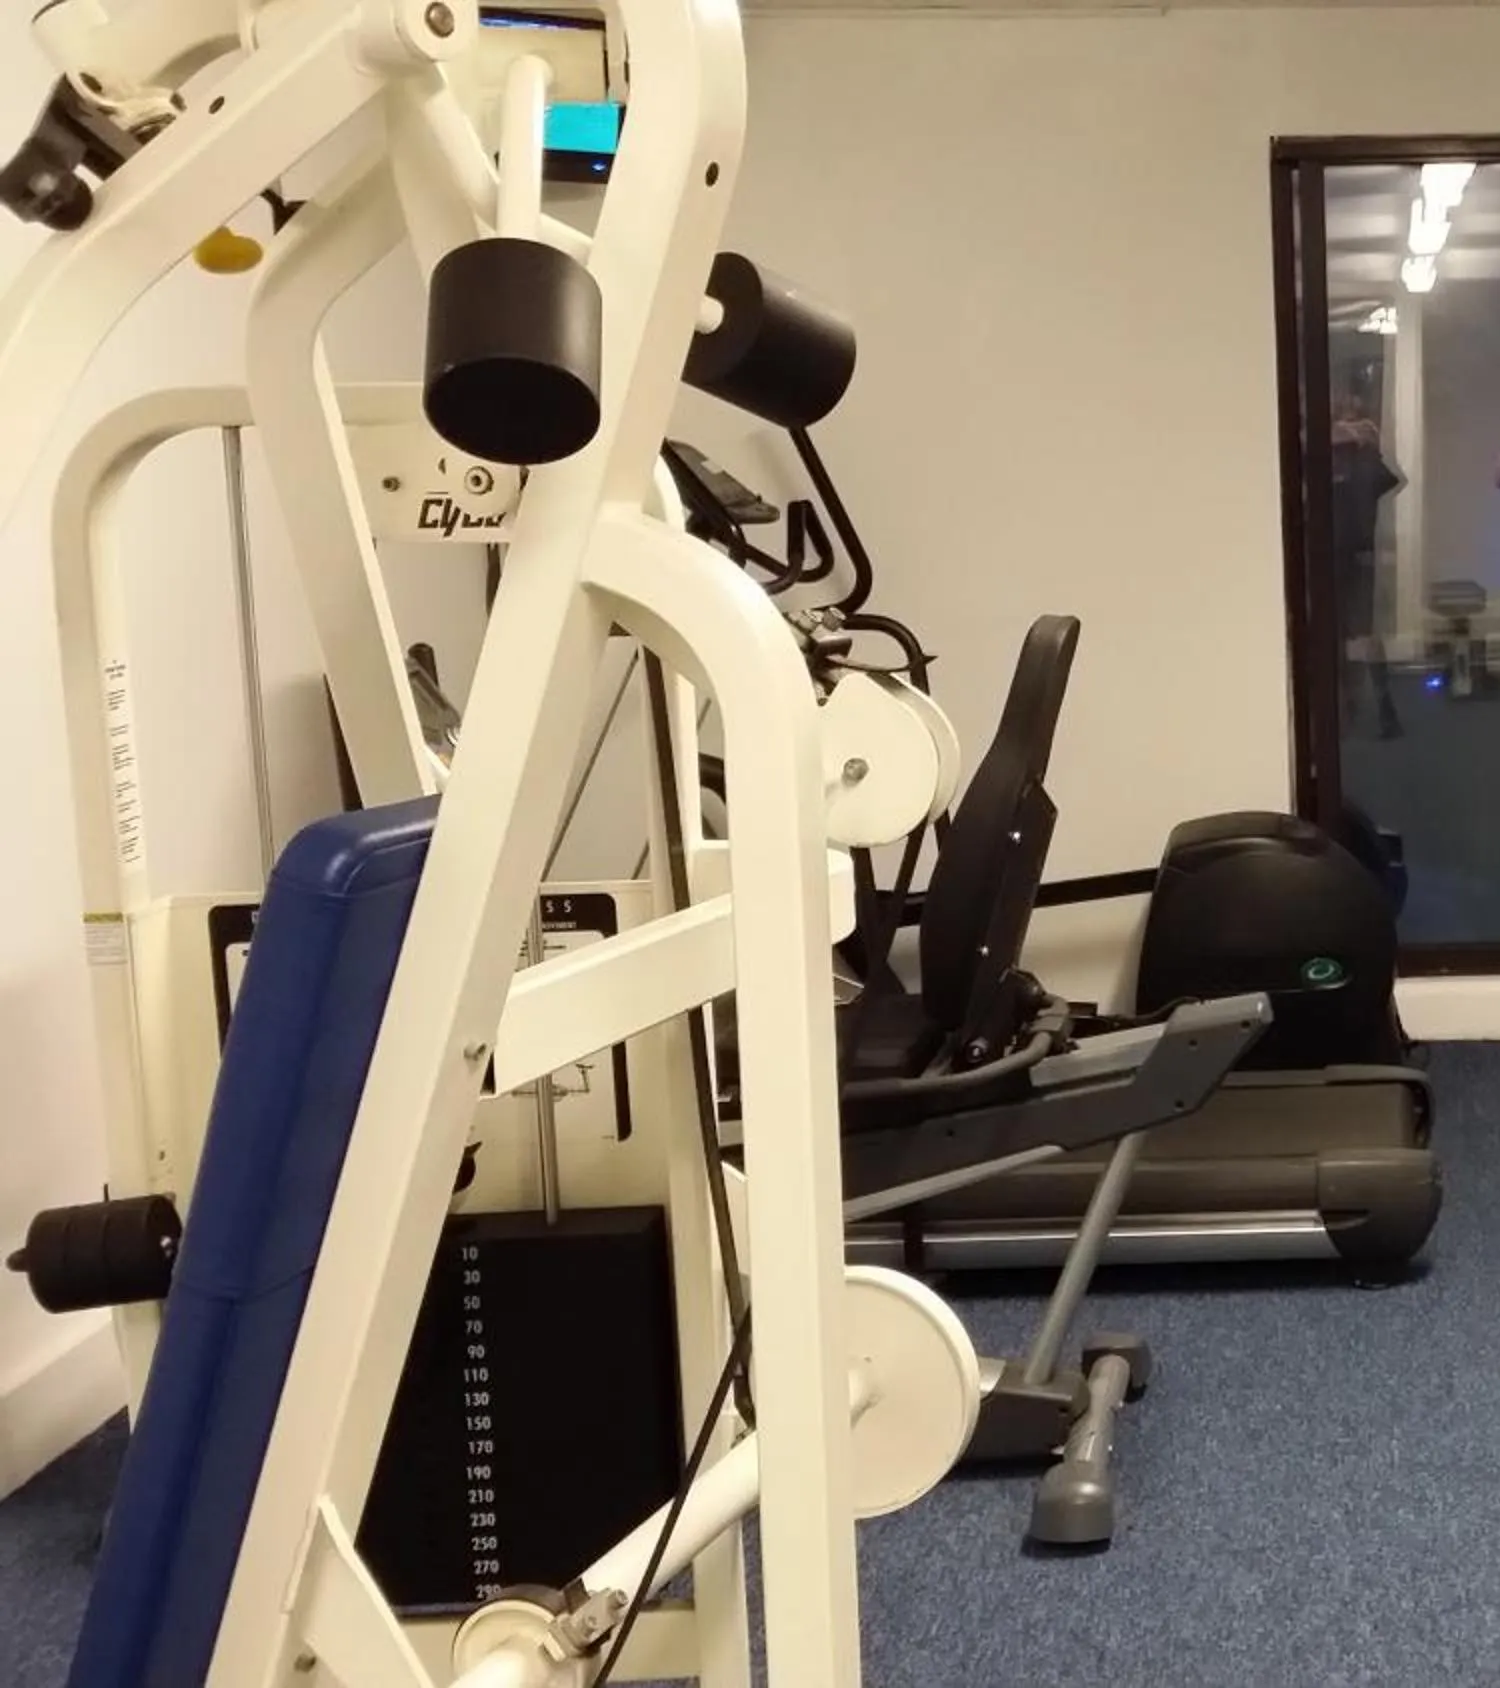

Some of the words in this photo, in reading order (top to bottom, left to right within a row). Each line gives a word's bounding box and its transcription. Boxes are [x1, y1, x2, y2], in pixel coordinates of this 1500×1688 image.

[462, 1246, 479, 1261] 10
[463, 1269, 481, 1285] 30
[463, 1295, 481, 1310] 50
[465, 1319, 483, 1334] 70
[467, 1344, 485, 1359] 90
[463, 1367, 489, 1382] 110
[464, 1392, 490, 1406] 130
[466, 1416, 491, 1430] 150
[468, 1440, 494, 1454] 170
[466, 1465, 491, 1480] 190
[467, 1489, 494, 1504] 210
[469, 1513, 496, 1527] 230
[471, 1536, 498, 1551] 250
[473, 1560, 500, 1575] 270
